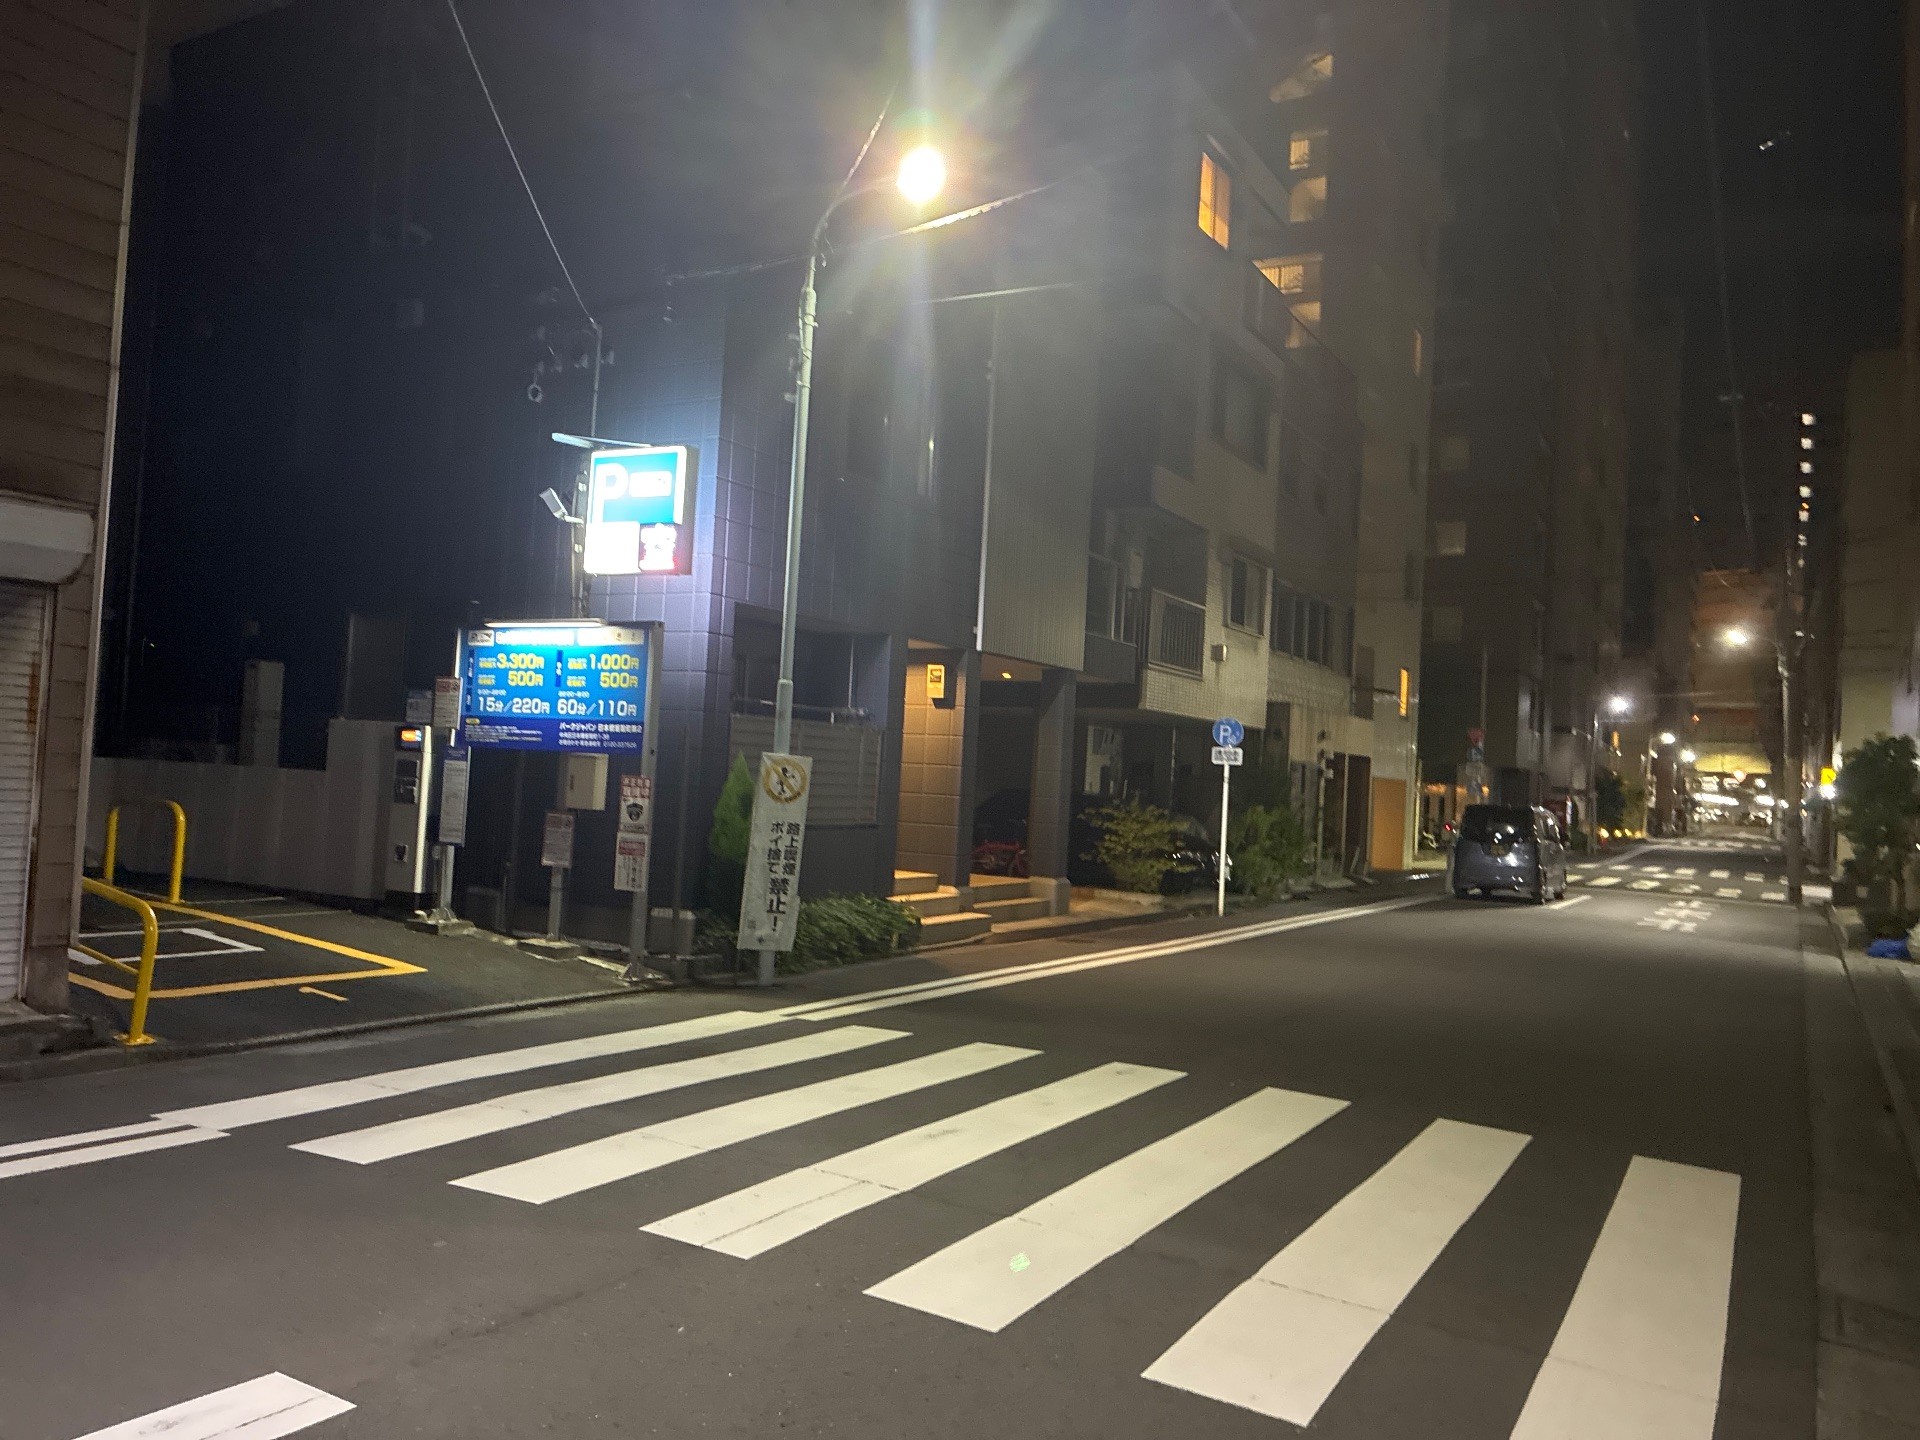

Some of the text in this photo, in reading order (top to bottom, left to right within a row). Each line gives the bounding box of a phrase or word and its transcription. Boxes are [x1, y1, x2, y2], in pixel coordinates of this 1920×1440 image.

[592, 463, 629, 523] P
[507, 670, 543, 686] 500円
[600, 671, 638, 688] 500円
